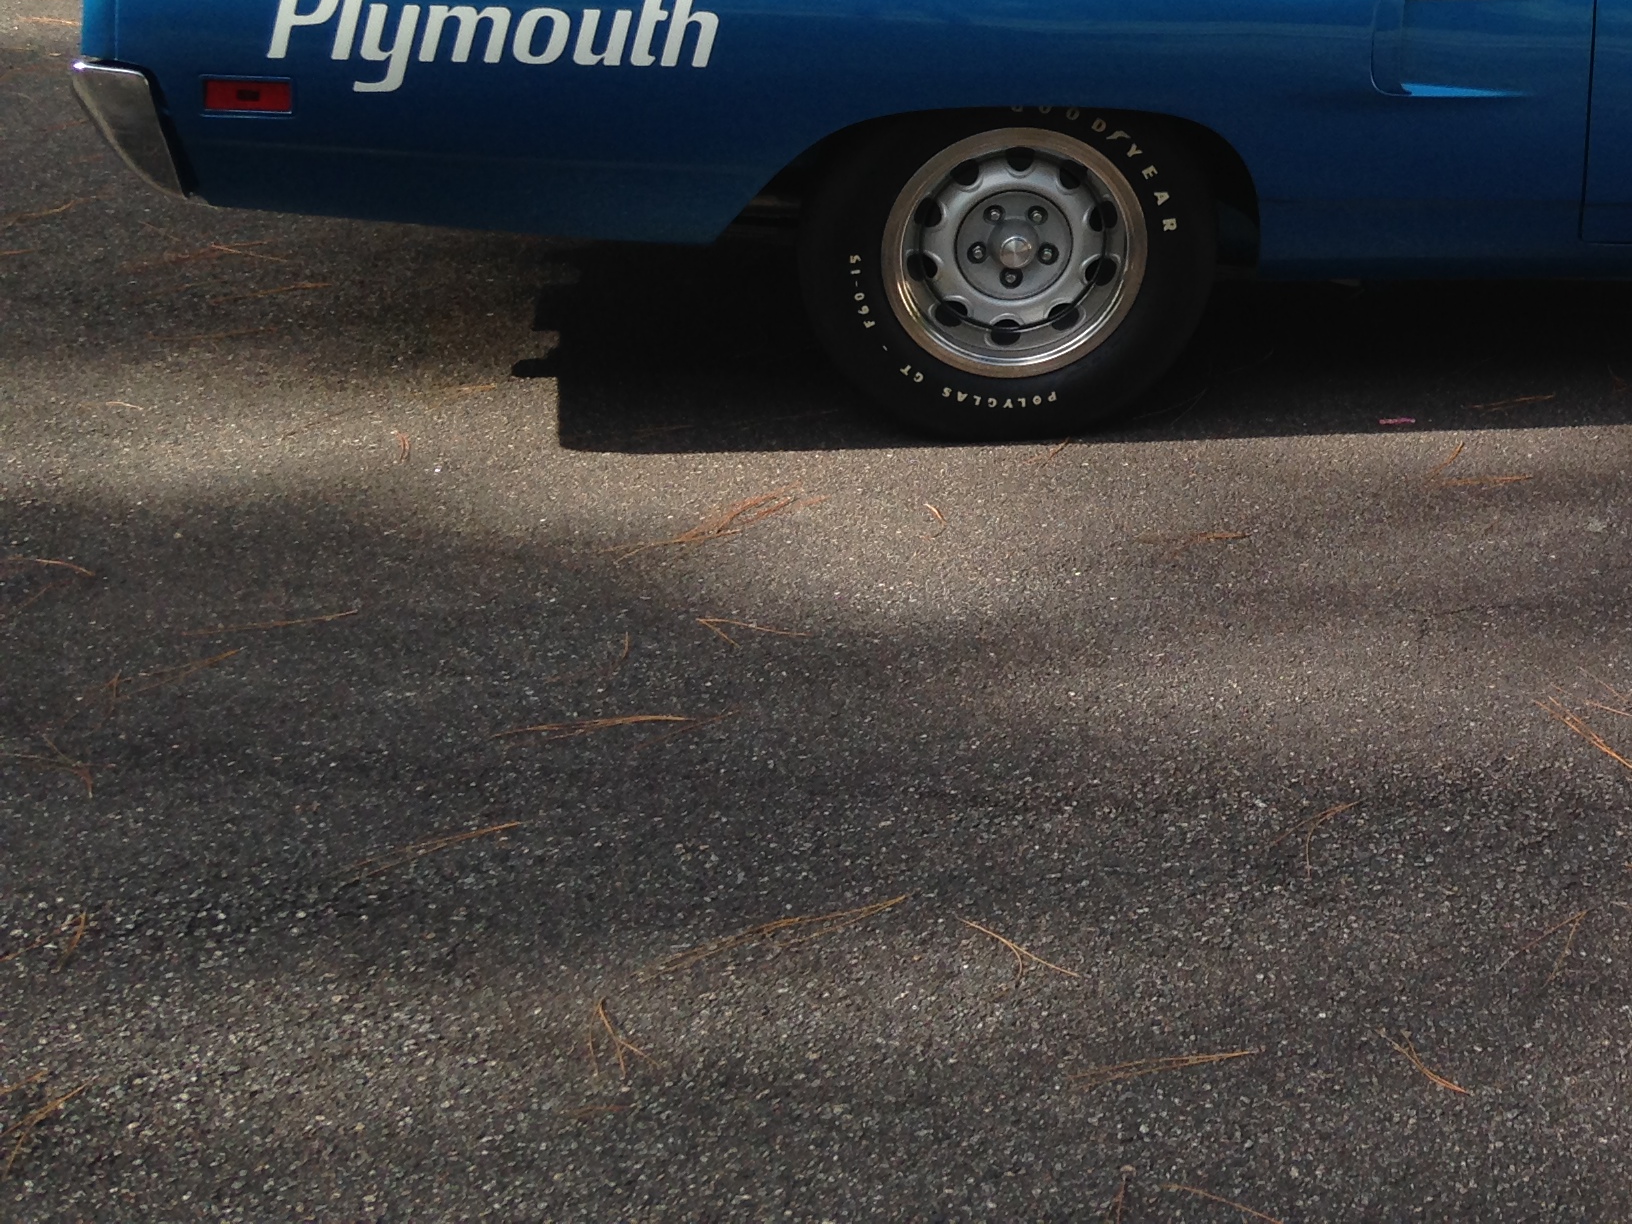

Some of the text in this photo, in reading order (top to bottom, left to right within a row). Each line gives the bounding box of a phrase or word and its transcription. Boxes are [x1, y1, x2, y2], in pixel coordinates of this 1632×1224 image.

[849, 254, 876, 329] F60-15
[899, 364, 926, 383] GT
[941, 386, 1058, 409] POLYGLAS
